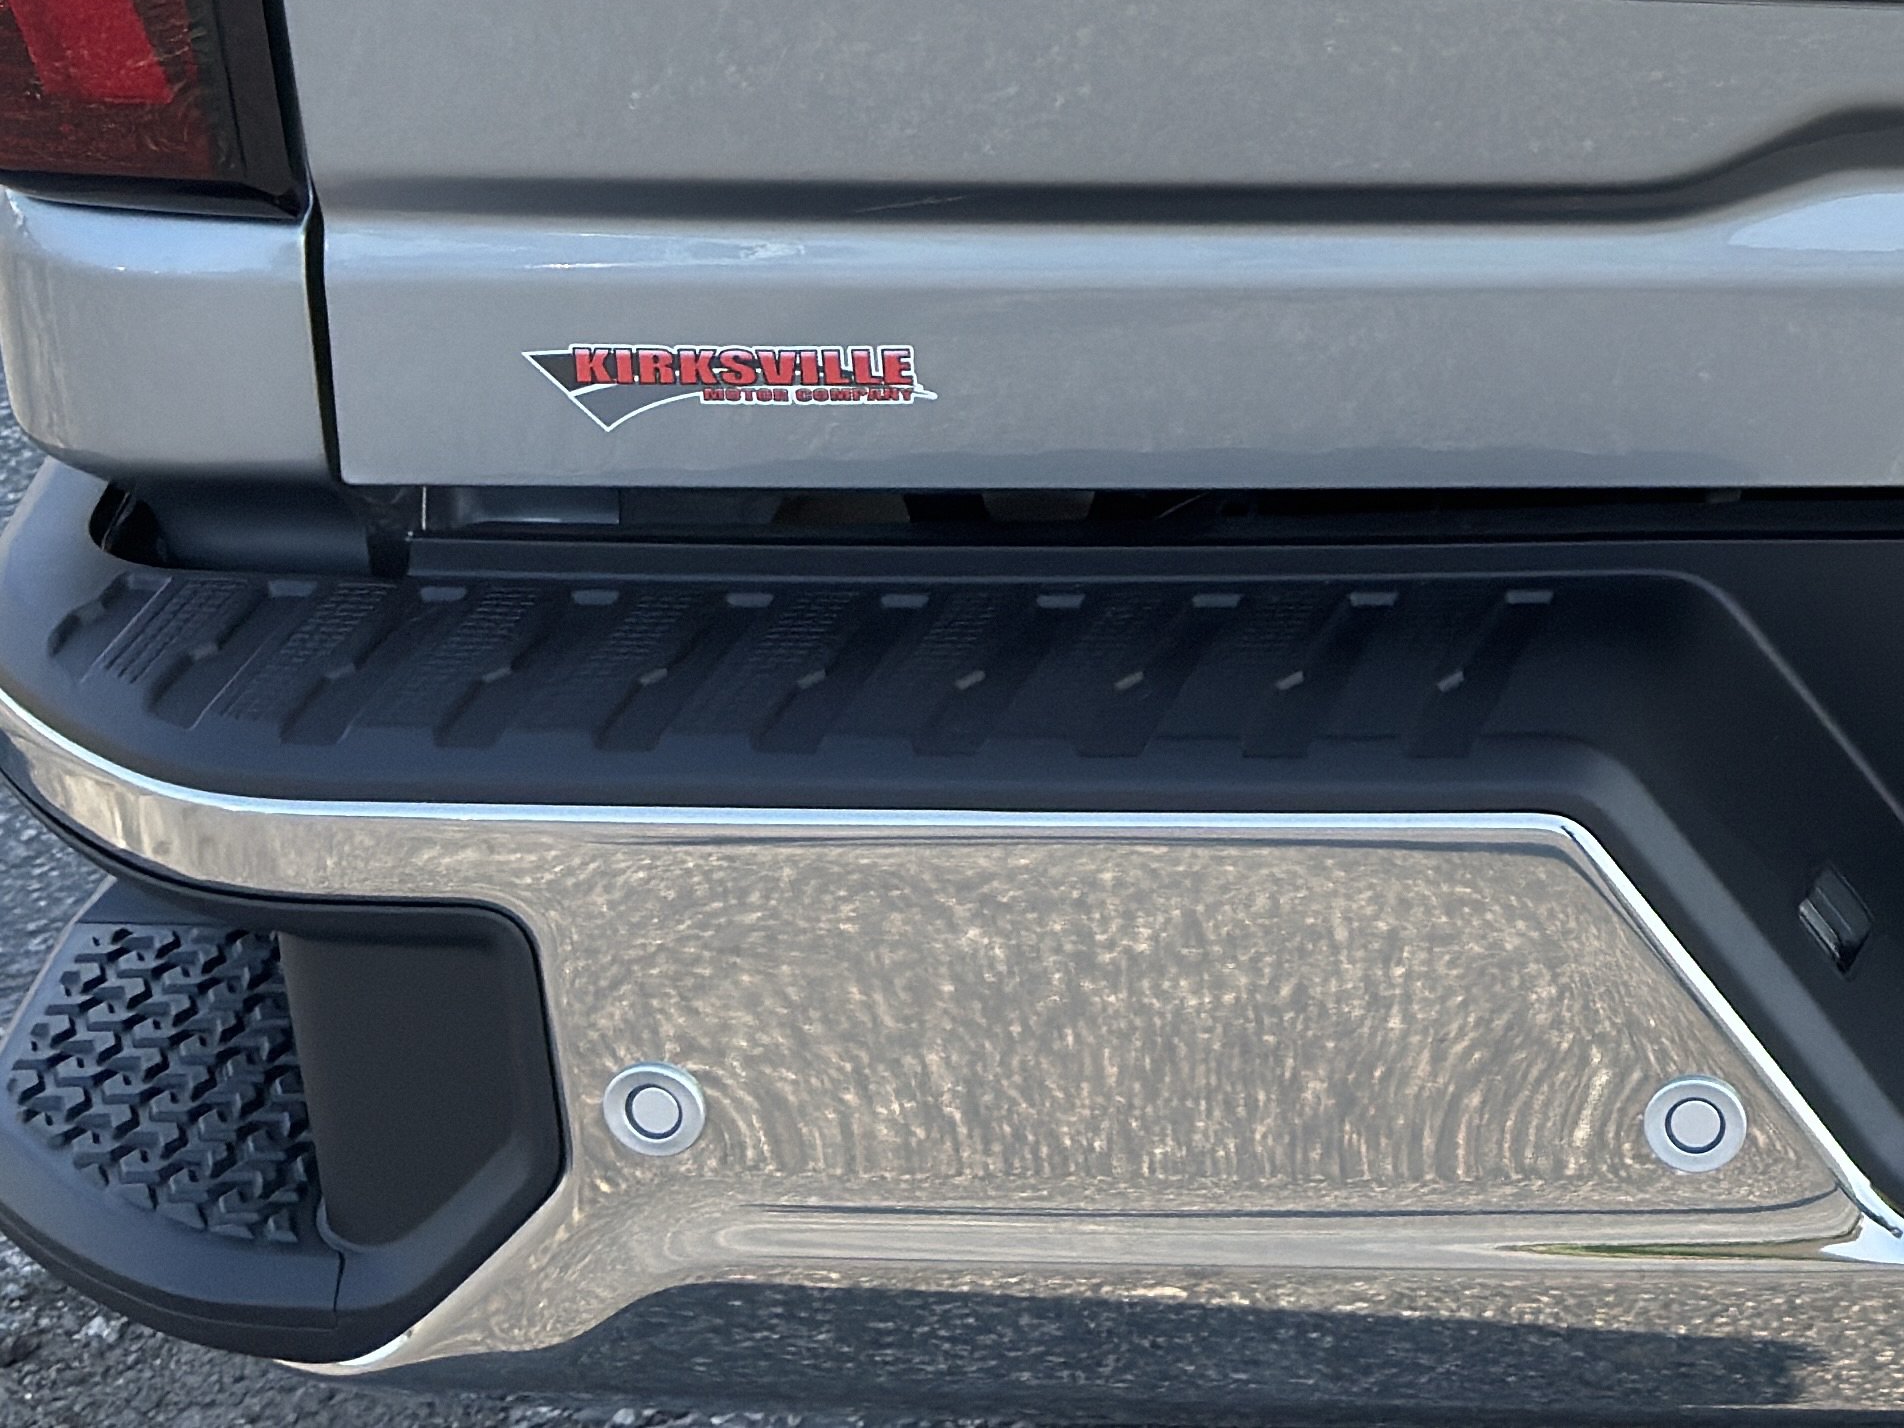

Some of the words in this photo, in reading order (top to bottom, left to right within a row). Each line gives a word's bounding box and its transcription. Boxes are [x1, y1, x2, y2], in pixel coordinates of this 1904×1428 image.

[571, 346, 915, 387] KIRKSVILLE
[702, 388, 790, 403] MOTOR
[795, 388, 915, 403] COMPANY
